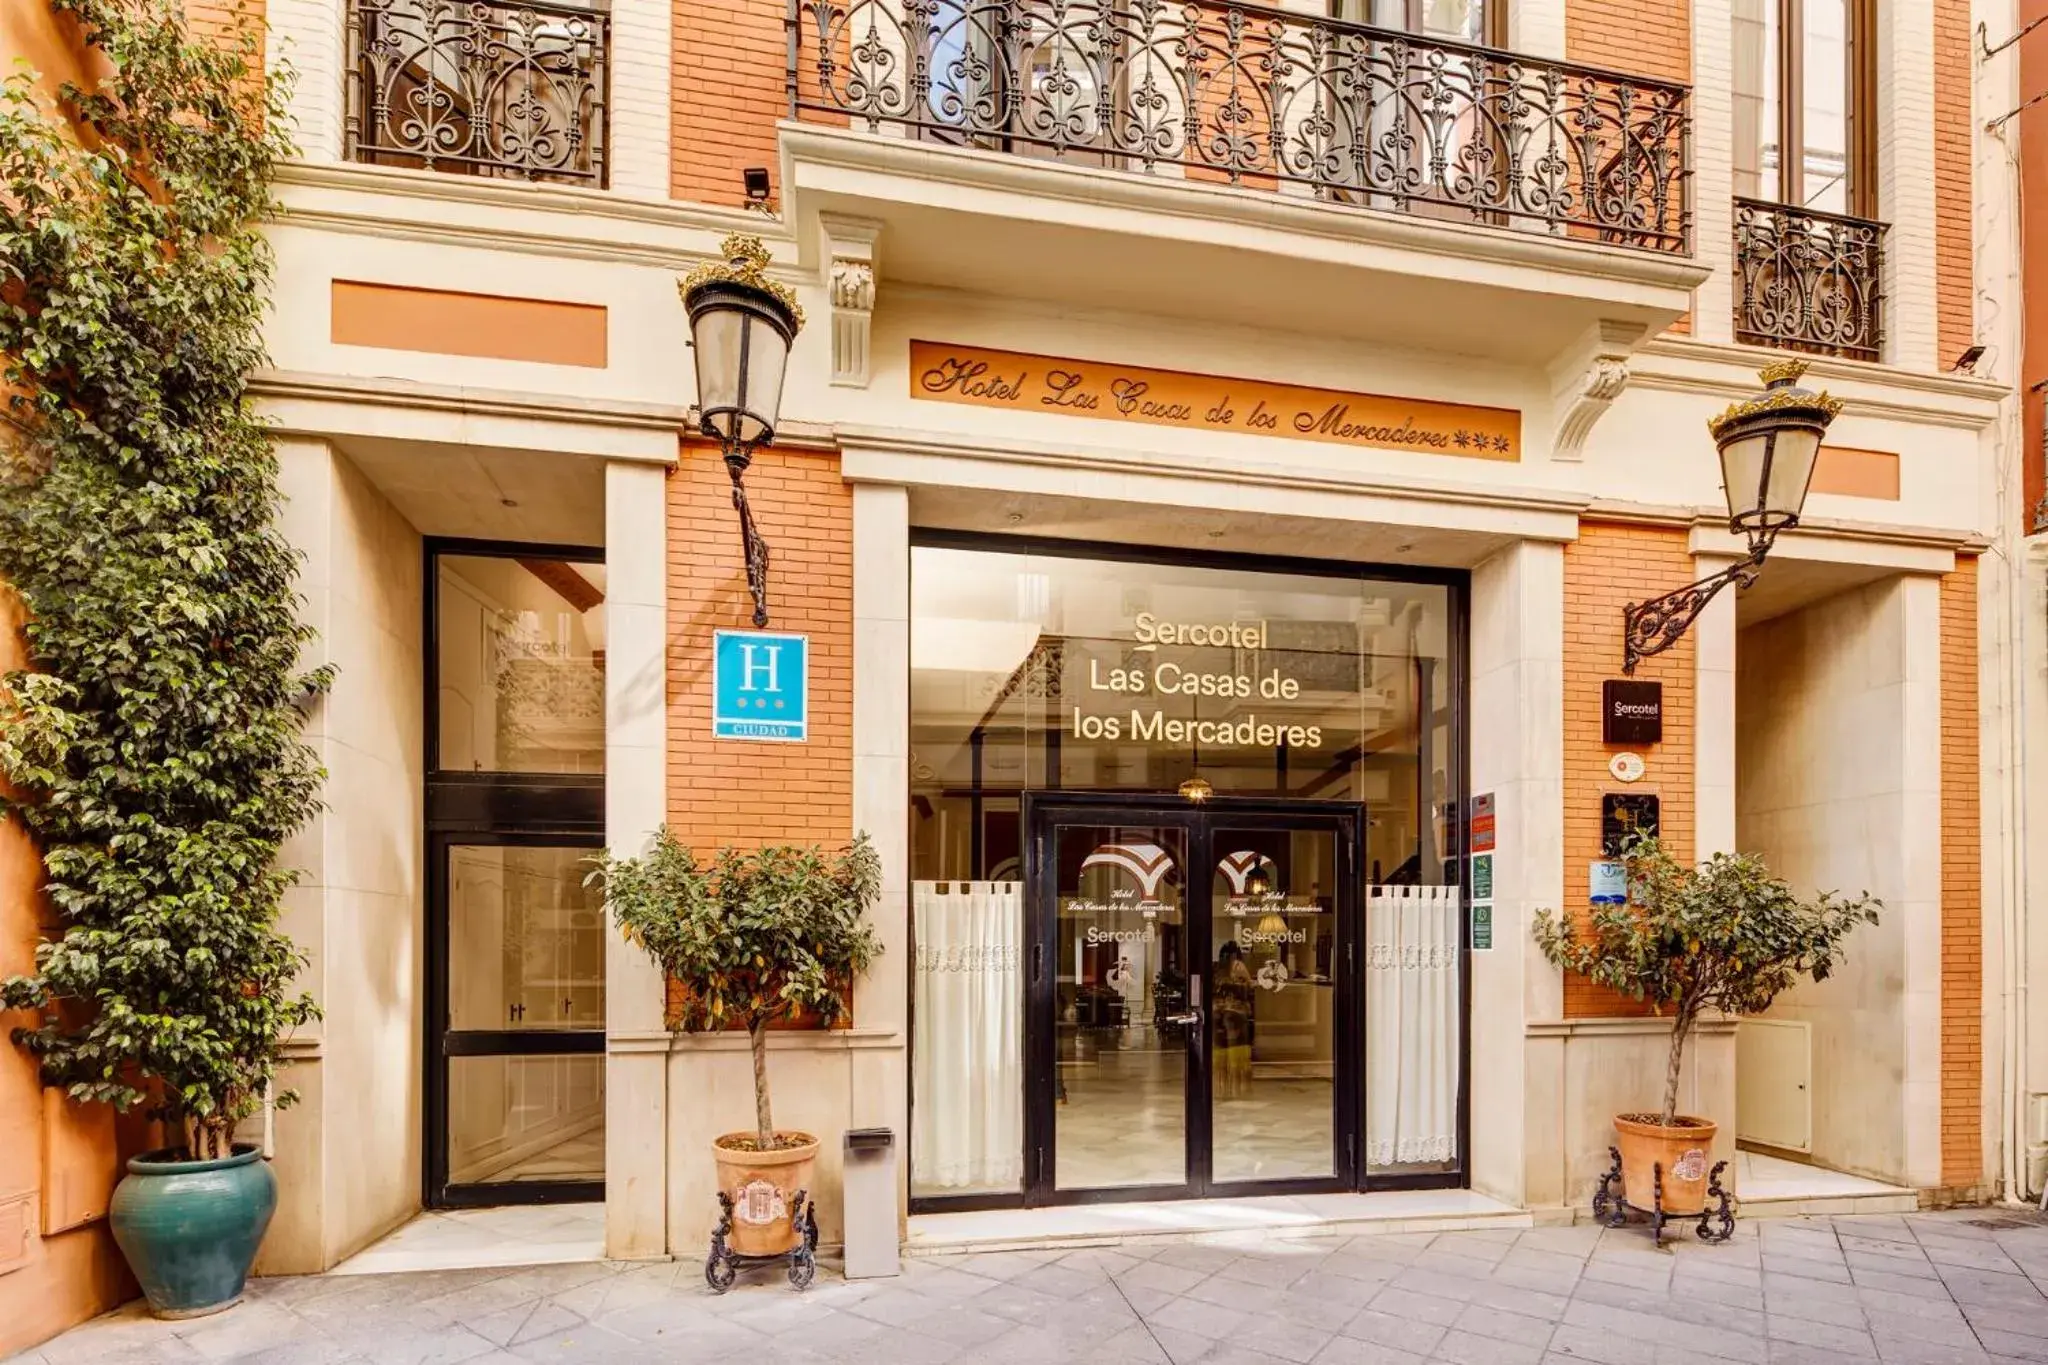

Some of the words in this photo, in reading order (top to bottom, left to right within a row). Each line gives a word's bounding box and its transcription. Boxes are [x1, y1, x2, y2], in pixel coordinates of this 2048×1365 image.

[921, 358, 1027, 401] Hotel
[1041, 370, 1099, 406] Las
[1111, 378, 1191, 416] Casas
[1204, 395, 1233, 424] de
[1247, 400, 1278, 429] los
[1293, 403, 1450, 449] Mercaderes
[1134, 612, 1267, 650] Sercotel
[738, 643, 783, 692] H
[1090, 659, 1146, 692] Las
[1154, 662, 1251, 697] Casas
[1259, 668, 1299, 700] de
[1073, 706, 1120, 740] los
[1130, 709, 1322, 748] Mercaderes
[1614, 701, 1659, 716] Sercotel
[733, 723, 788, 737] CIUDAD
[1087, 926, 1155, 947] Sercotel
[1242, 927, 1307, 948] Sercotel
